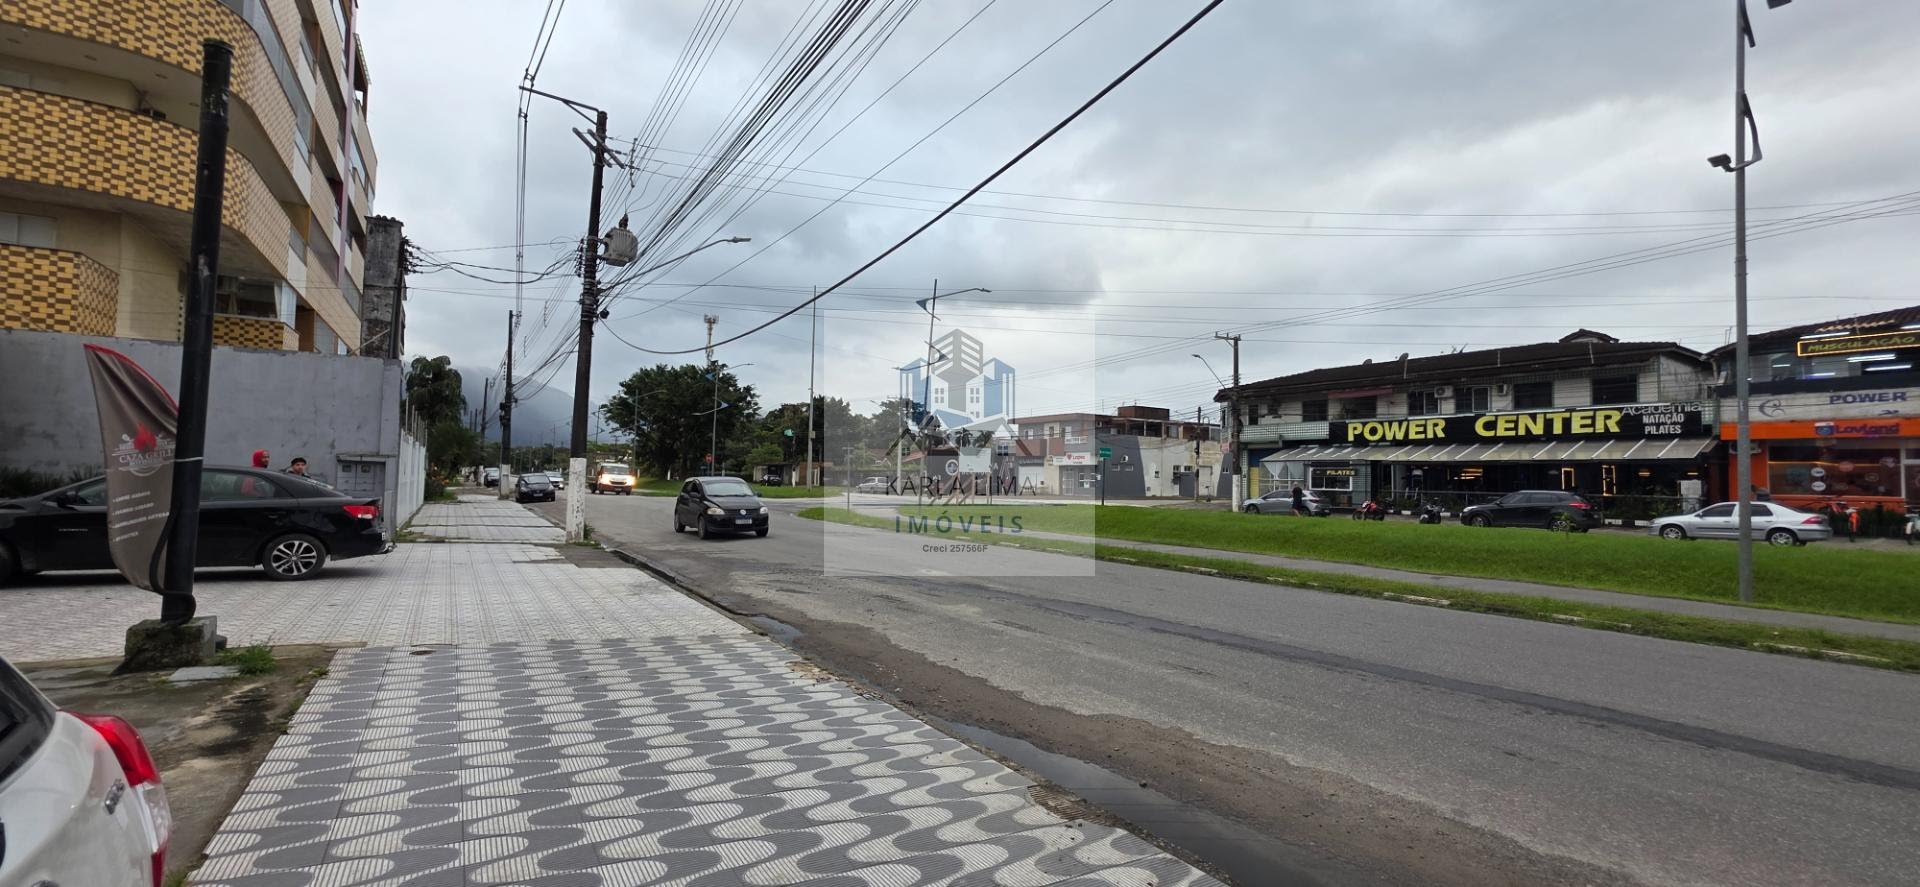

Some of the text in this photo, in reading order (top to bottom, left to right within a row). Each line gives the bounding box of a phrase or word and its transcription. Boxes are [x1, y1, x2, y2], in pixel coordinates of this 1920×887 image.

[1829, 391, 1907, 405] POWER
[1620, 401, 1703, 417] Academia
[1642, 411, 1685, 425] NATAÇÃO
[1347, 409, 1621, 442] POWER CENTER
[1644, 423, 1682, 435] PILATES
